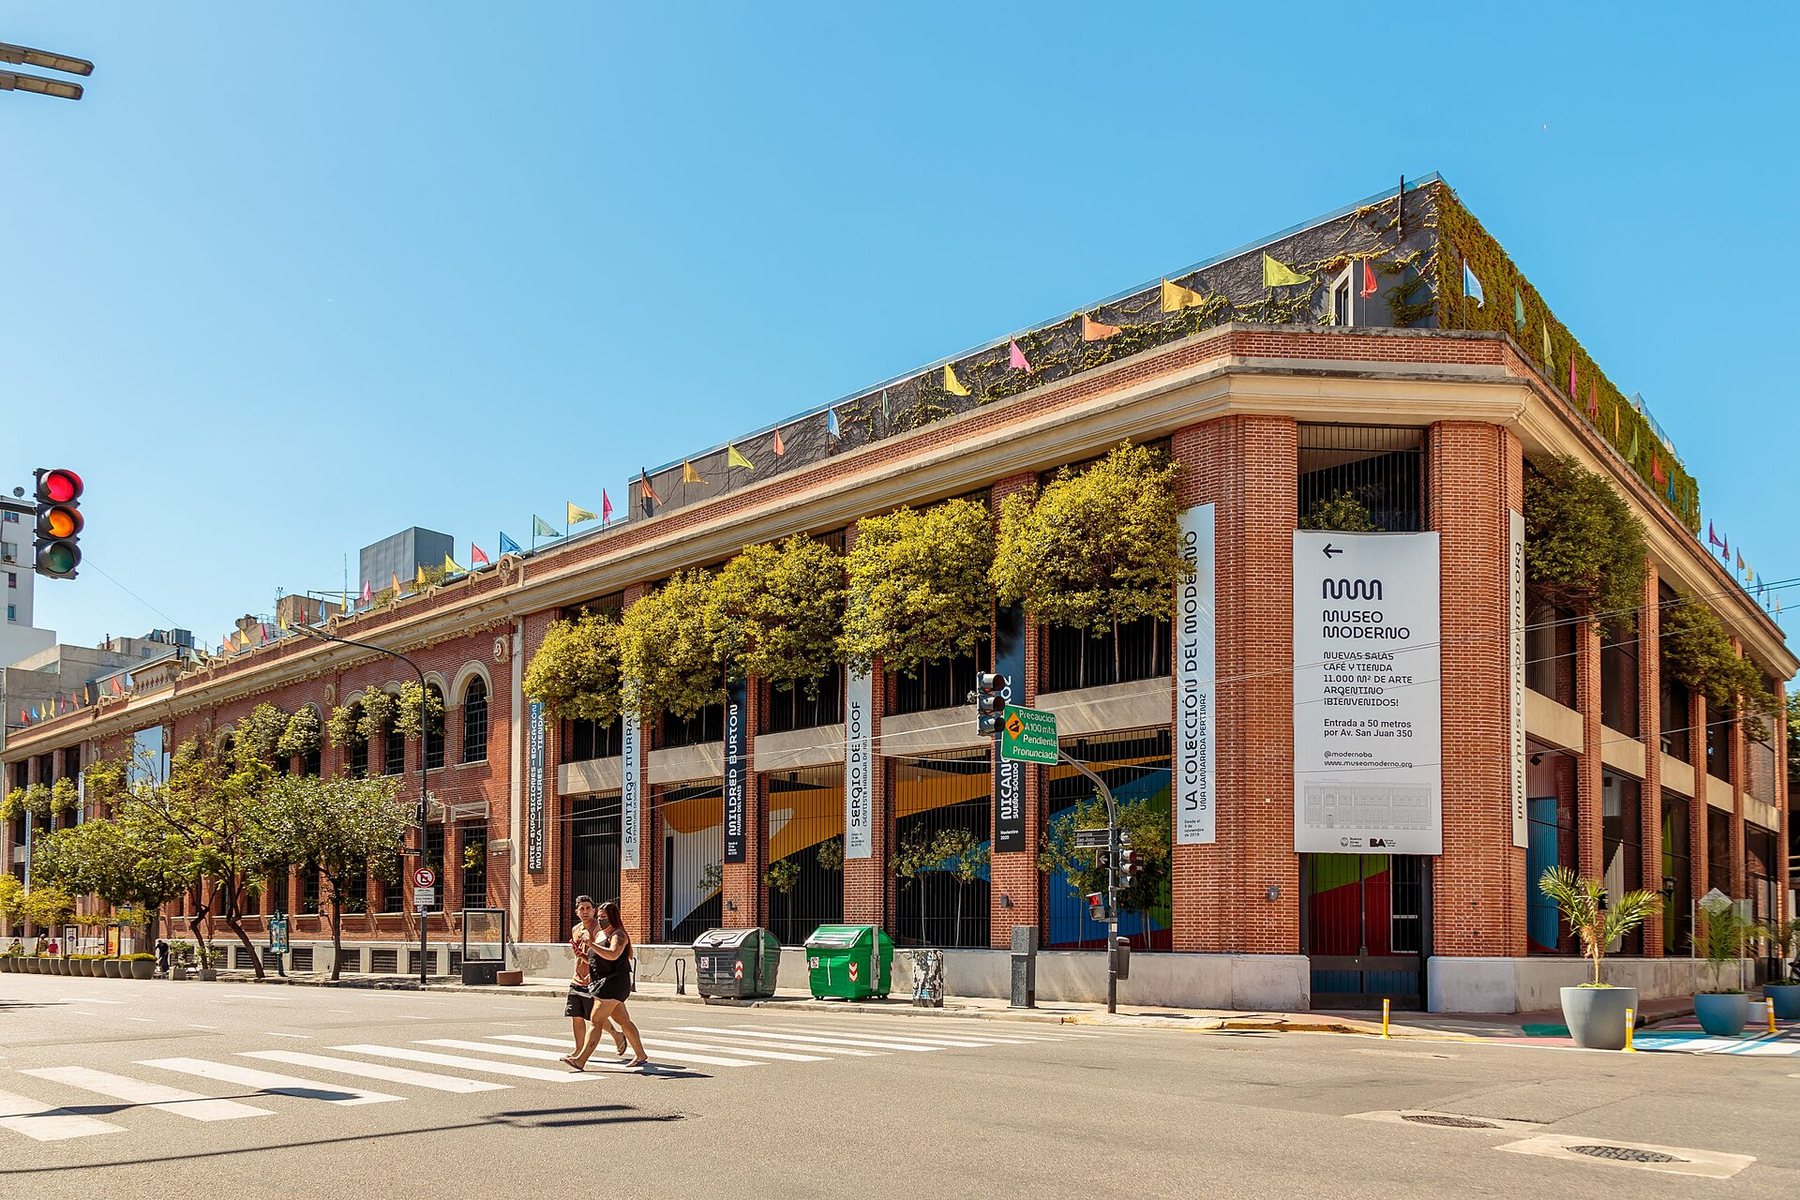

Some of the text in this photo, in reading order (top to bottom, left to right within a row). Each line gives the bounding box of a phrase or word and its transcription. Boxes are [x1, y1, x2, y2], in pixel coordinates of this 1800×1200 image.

[1323, 610, 1383, 622] MUSEO
[1323, 626, 1410, 639] MODERNO
[1182, 531, 1197, 810] LA COLECCIÓN DEL MODENO
[1324, 662, 1346, 671] CAFÉ
[1324, 686, 1383, 696] ARGENTINO
[1324, 698, 1399, 706] ¡BIENVENIDOS!
[851, 701, 860, 740] LOOF
[728, 704, 737, 764] BURTON
[1023, 734, 1057, 746] Pendiente
[852, 744, 860, 762] DE
[1013, 746, 1058, 759] Pronunciada
[728, 769, 737, 836] MILDRED
[851, 768, 862, 827] SERGIO
[626, 772, 634, 844] SANTIAGO
